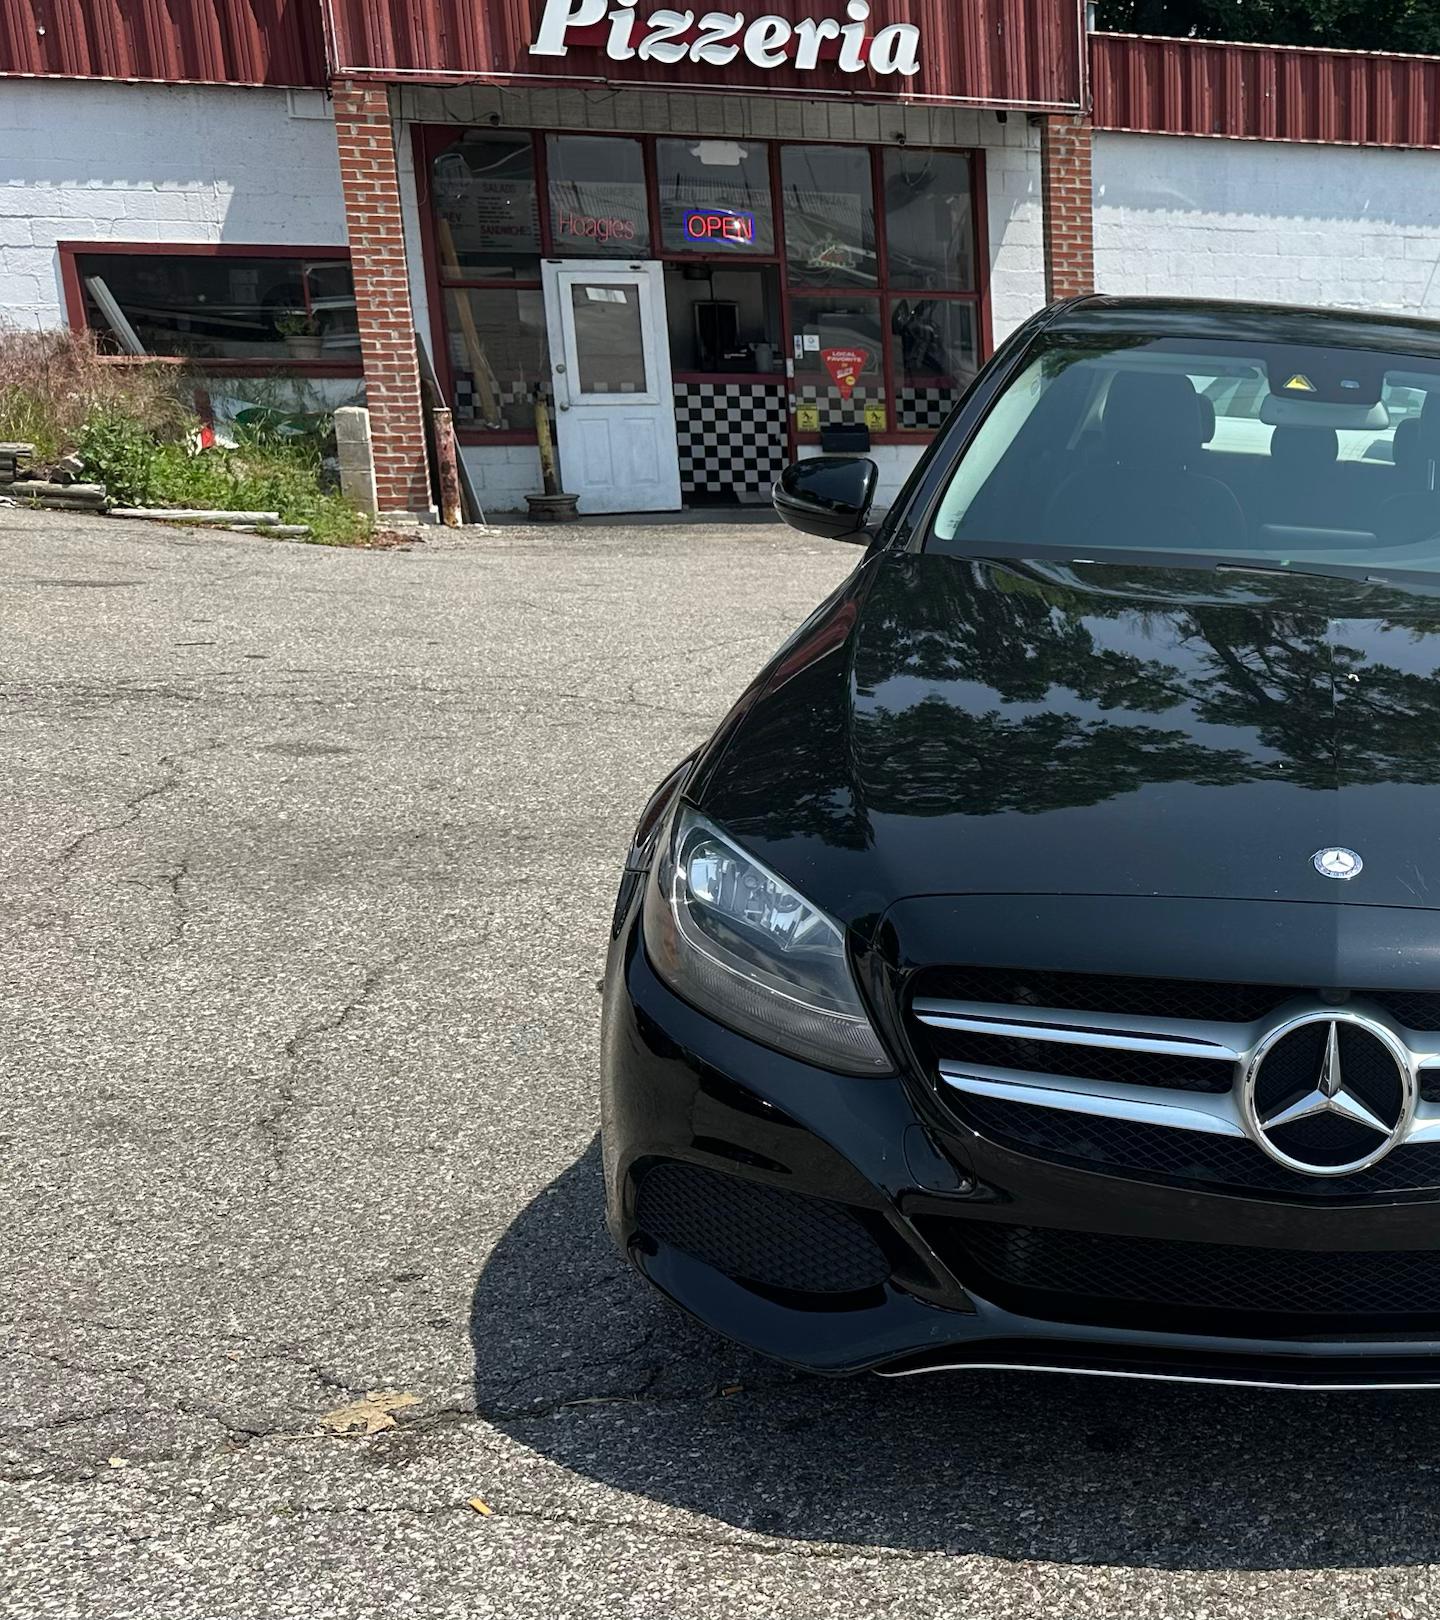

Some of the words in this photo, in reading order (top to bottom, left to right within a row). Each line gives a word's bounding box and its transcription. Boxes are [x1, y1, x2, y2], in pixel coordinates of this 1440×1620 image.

[529, 0, 921, 76] Pizzeria
[559, 207, 634, 244] Hoagies
[688, 215, 752, 240] OPEN
[826, 355, 862, 363] FAVORITE
